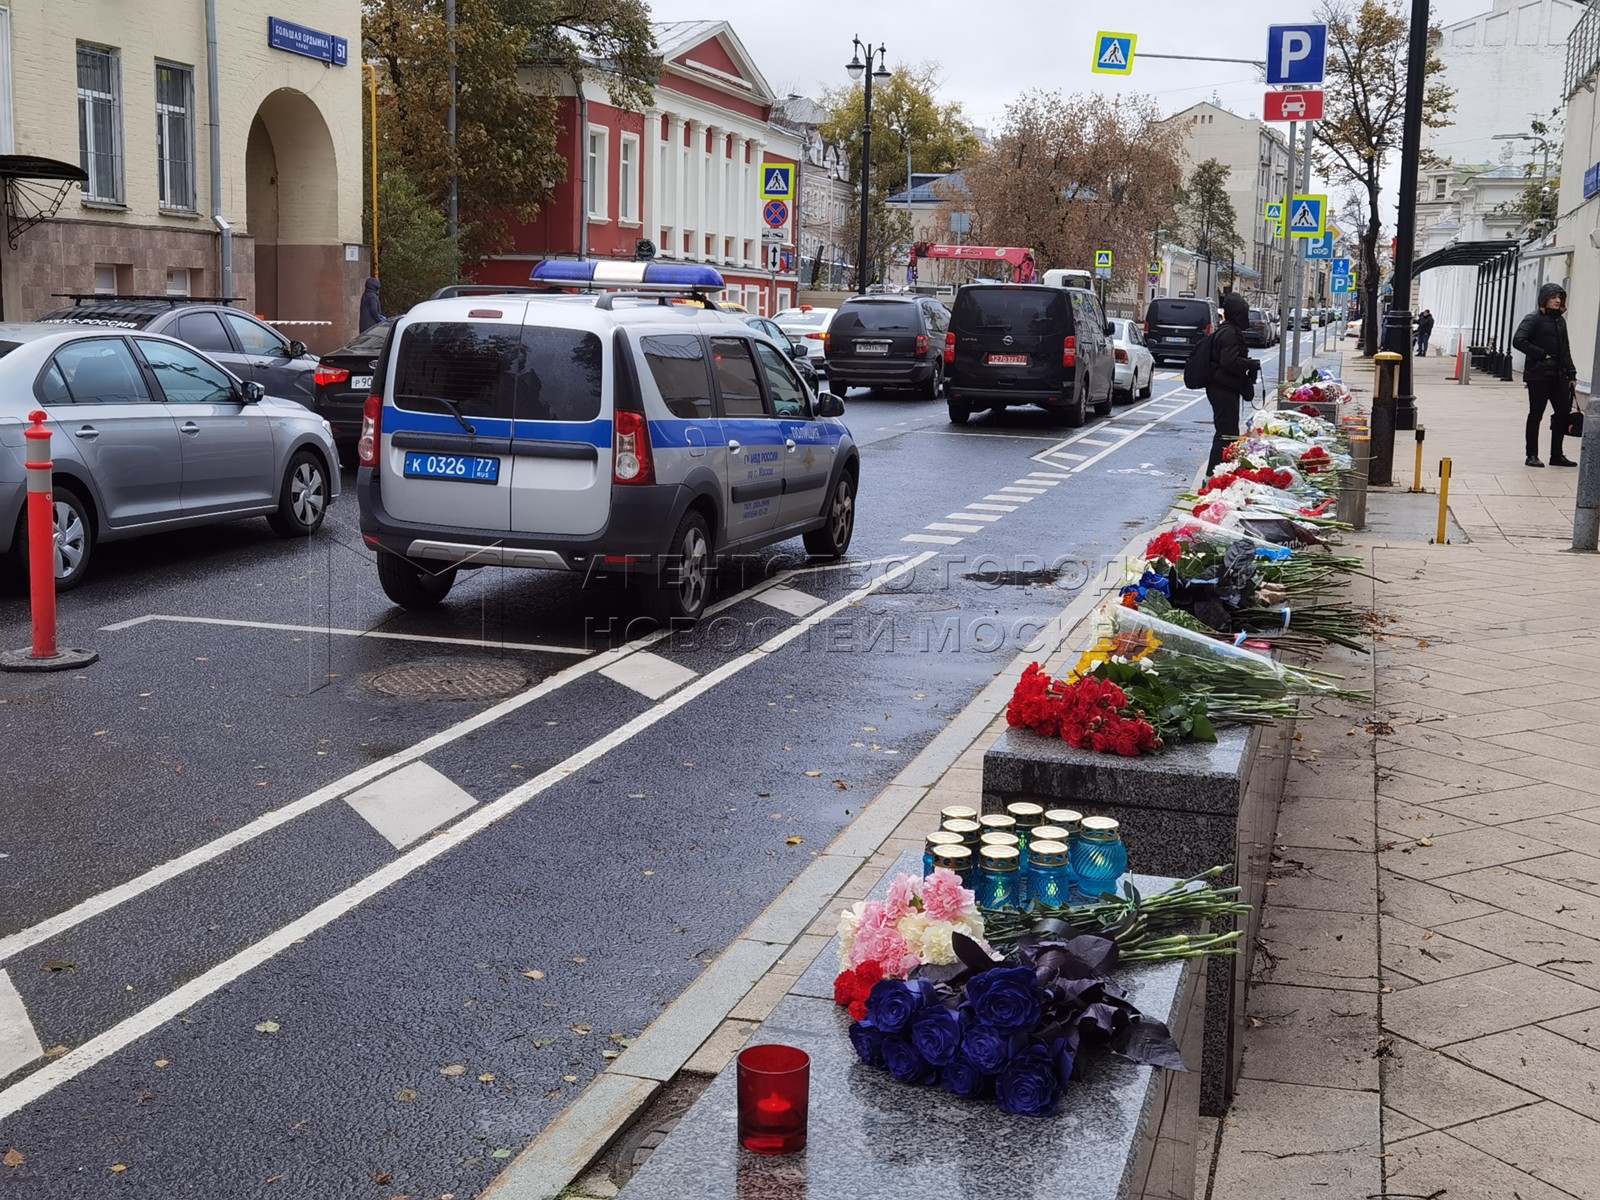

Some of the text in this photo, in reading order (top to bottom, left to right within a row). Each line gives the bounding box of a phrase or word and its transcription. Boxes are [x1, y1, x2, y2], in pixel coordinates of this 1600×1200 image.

[275, 25, 329, 49] БОЛЬШАЯ ОРДЫНКА
[337, 43, 346, 59] 51
[1280, 30, 1312, 78] P
[790, 426, 820, 441] ПОЛИЦИЯ
[412, 456, 493, 475] К 0326 77
[750, 453, 761, 464] МВД
[761, 451, 778, 462] РОССИИ
